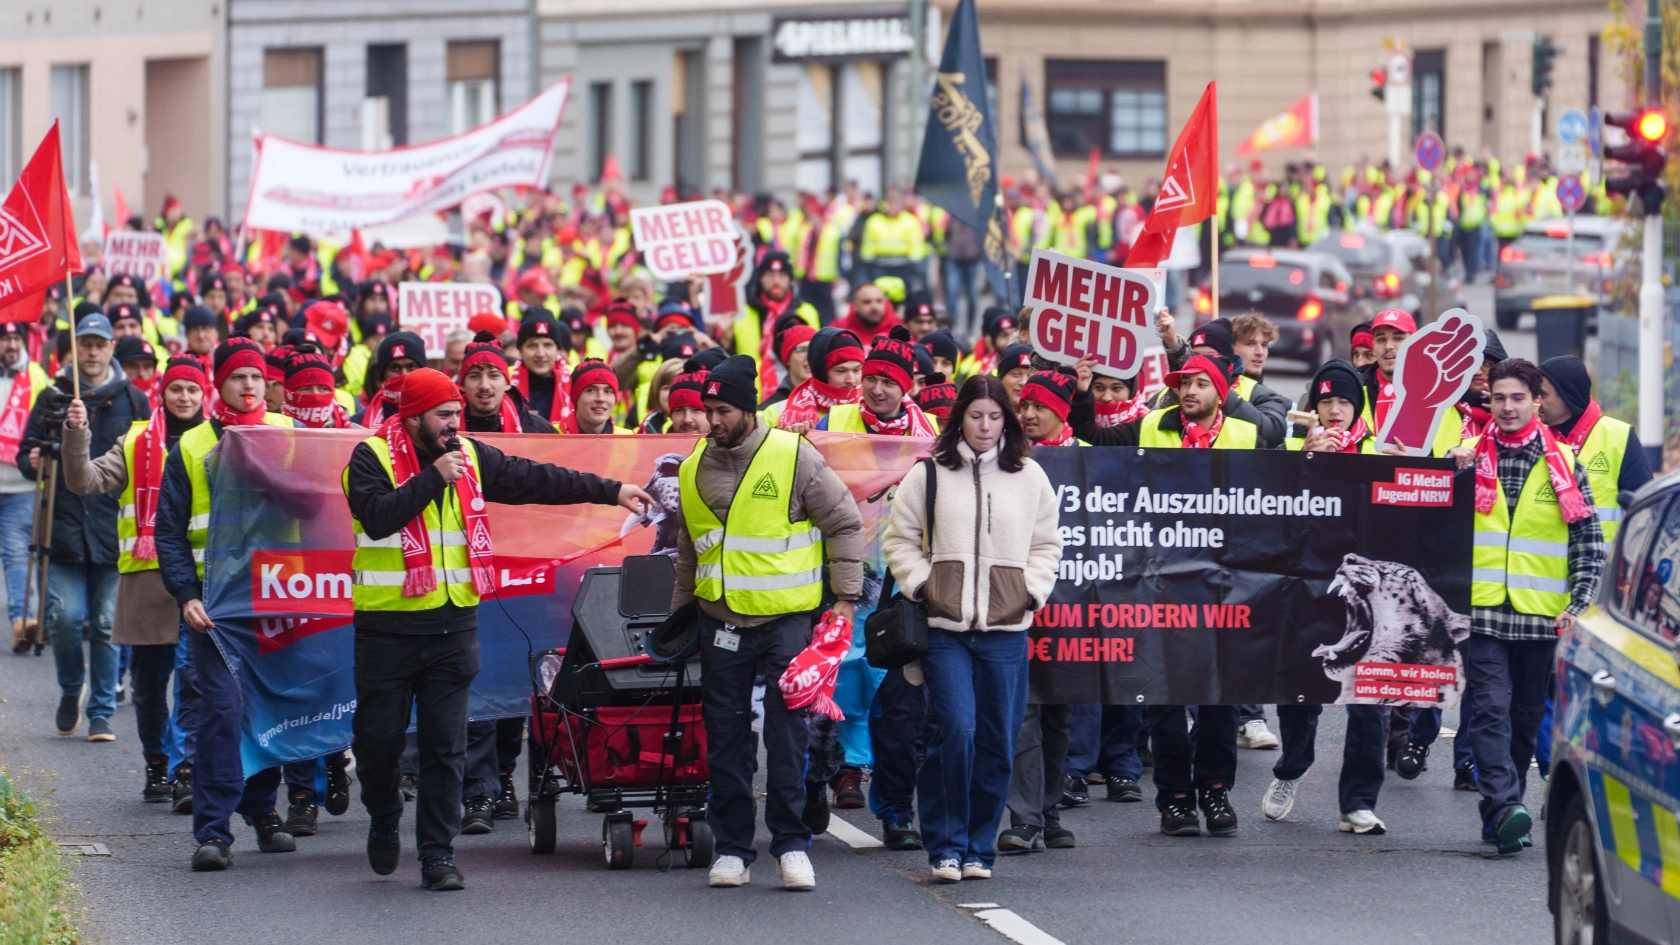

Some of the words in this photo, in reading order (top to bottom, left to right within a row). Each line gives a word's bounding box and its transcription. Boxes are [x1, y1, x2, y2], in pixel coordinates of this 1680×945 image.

[638, 207, 729, 242] MEHR
[110, 238, 161, 258] MEHR
[653, 239, 729, 272] GELD
[406, 289, 495, 318] MEHR
[1032, 257, 1149, 328] MEHR
[875, 339, 916, 362] NRW
[1036, 308, 1138, 371] GELD
[920, 386, 958, 405] NRW
[1398, 473, 1412, 486] IG
[1413, 474, 1451, 488] Metall
[1085, 486, 1129, 513] der
[1133, 486, 1342, 517] Auszubildenden
[1377, 487, 1419, 503] Jugend
[1421, 490, 1451, 503] NRW
[1090, 519, 1153, 547] nicht
[1158, 520, 1224, 548] ohne
[1088, 603, 1197, 628] FORDERN
[1203, 604, 1252, 629] WIR
[1056, 637, 1134, 662] MEHR!
[1357, 665, 1398, 679] Komm,
[1400, 667, 1419, 678] wir
[1421, 669, 1454, 680] holen
[1356, 686, 1378, 694] uns
[1380, 684, 1401, 695] das
[1404, 686, 1437, 698] Geld!
